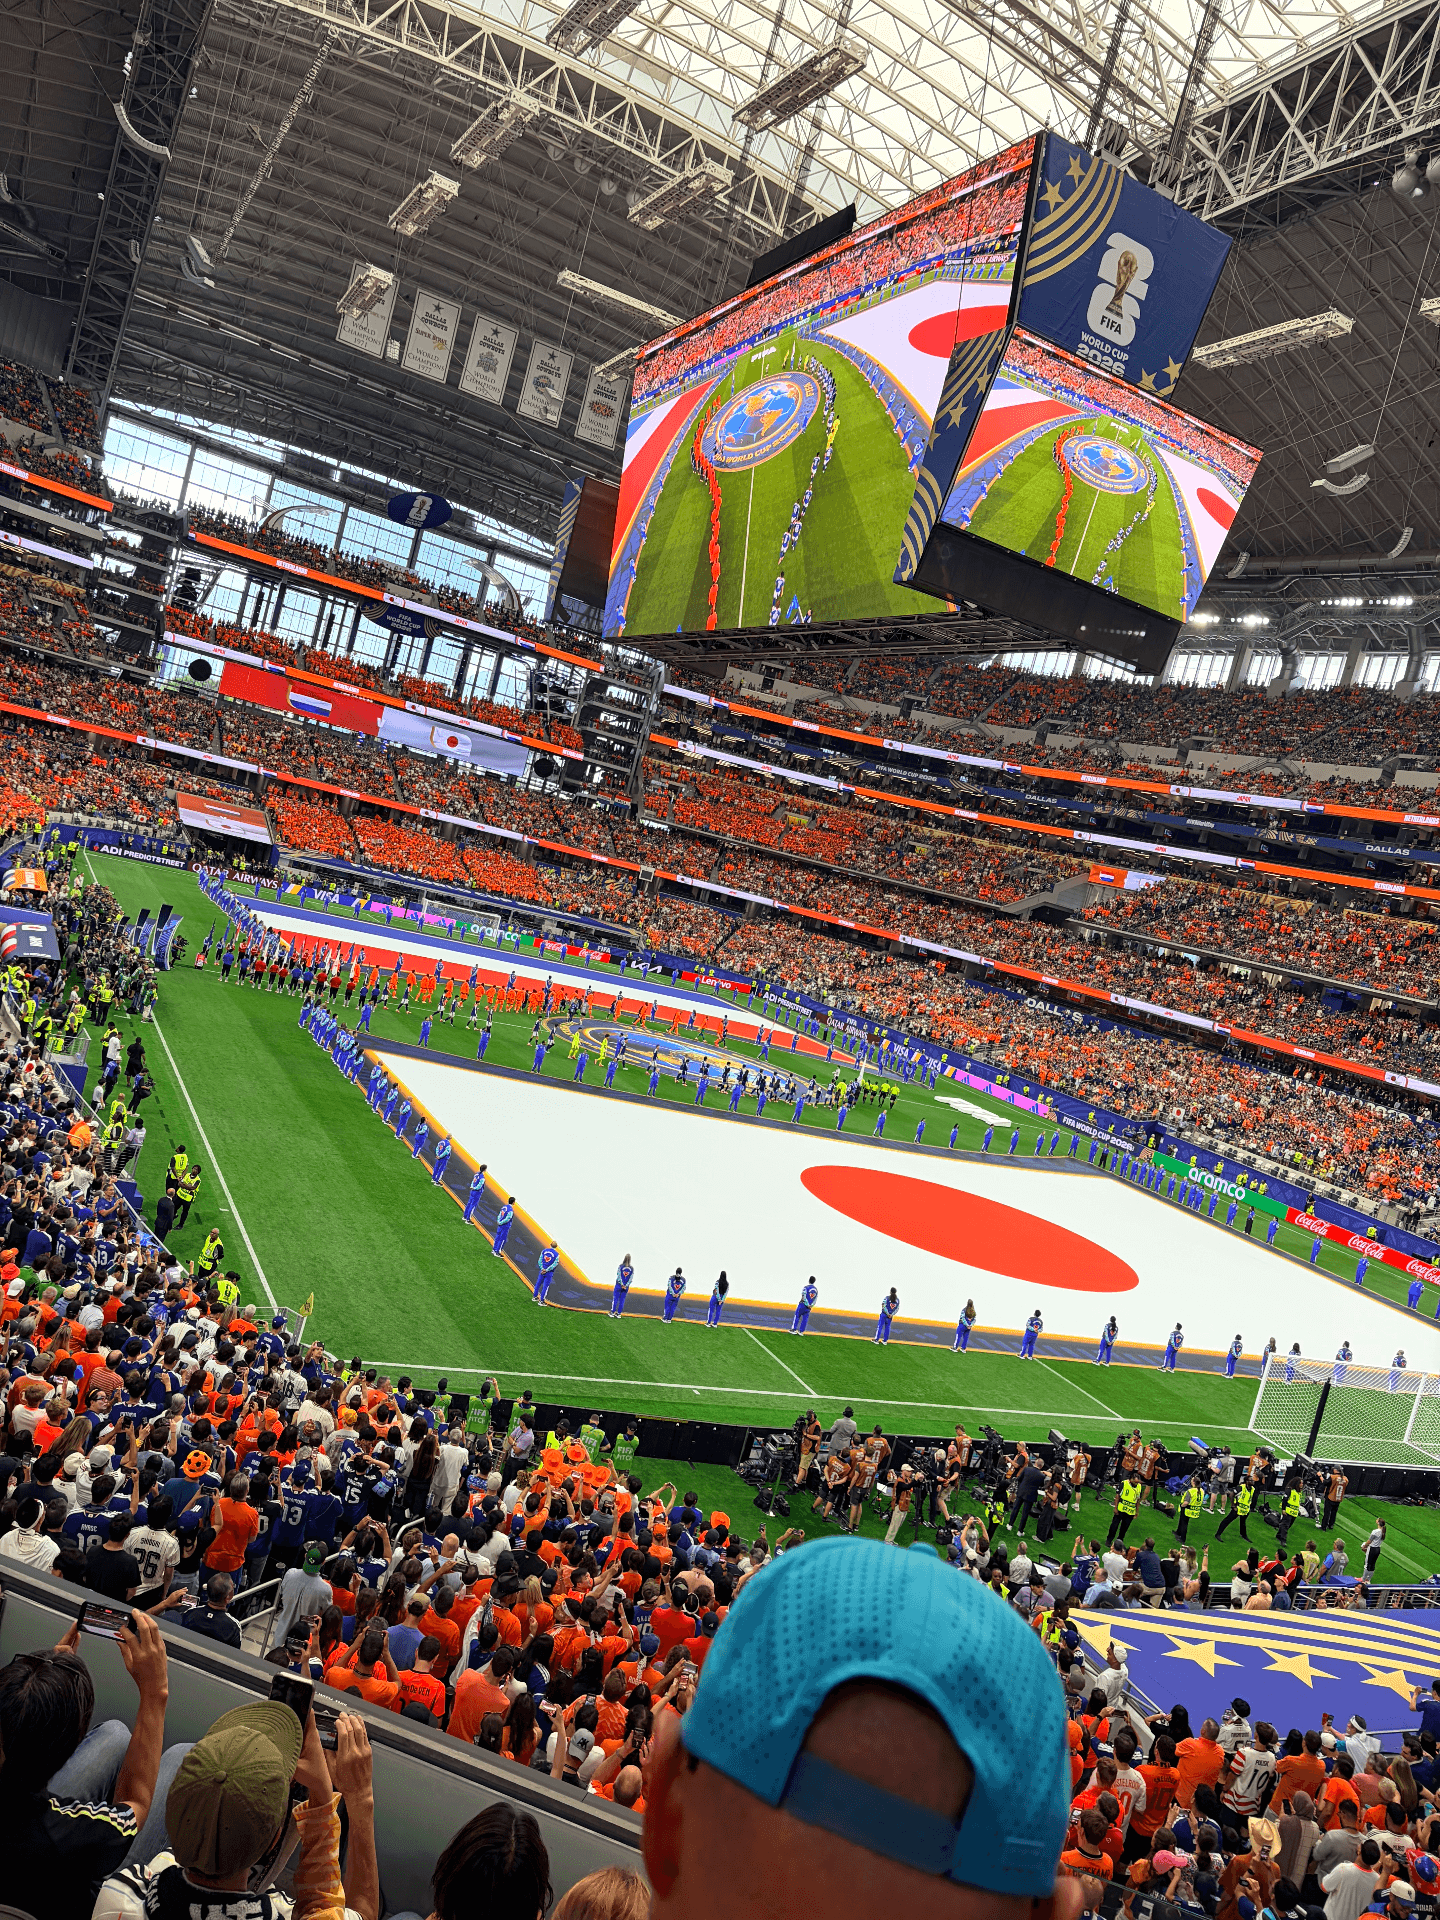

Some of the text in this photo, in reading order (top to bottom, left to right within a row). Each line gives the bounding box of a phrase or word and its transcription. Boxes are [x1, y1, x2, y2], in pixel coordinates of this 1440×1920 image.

[421, 317, 448, 332] COWBOYS
[424, 312, 447, 324] DALLAS
[1100, 315, 1122, 335] FIFA
[343, 325, 381, 346] CHAMPIONS
[352, 321, 376, 336] WORLD
[415, 328, 431, 339] SUPER
[479, 340, 505, 355] COWBOYS
[483, 335, 504, 348] DALLAS
[1081, 331, 1129, 362] WORLD CUP
[407, 352, 444, 371] CHAMPIONS
[416, 348, 439, 362] WORLD
[1076, 343, 1126, 378] 2026
[536, 364, 561, 379] COWBOYS
[540, 360, 560, 372] DALLAS
[465, 375, 501, 394] CHAMPIONS
[474, 371, 496, 384] WORLD
[593, 388, 618, 402] COWBOYS
[596, 384, 617, 396] DALLAS
[580, 422, 614, 439] CHAMPIONS
[588, 418, 609, 431] WORLD
[725, 451, 754, 463] WORLD
[754, 444, 772, 457] CUP
[386, 614, 408, 626] WORLD
[398, 613, 412, 622] FIFA
[751, 734, 786, 748] DALLAS
[875, 764, 938, 782] FIFA WORLD CUP 2026
[1025, 794, 1057, 805] DALLAS
[1404, 814, 1440, 826] NETHERLANDS
[100, 844, 123, 856] ADI
[1365, 844, 1411, 857] DALLAS
[192, 862, 278, 890] QATAR AIRWAYS
[313, 889, 340, 904] VISA
[470, 923, 518, 943] aramco
[597, 945, 611, 954] FIFA
[762, 991, 777, 1004] ADI
[1025, 997, 1083, 1022] DALLS
[826, 1017, 845, 1031] QATAR
[847, 1017, 858, 1027] FIFA
[893, 1043, 909, 1058] VISA
[1062, 1116, 1134, 1151] FIFA WORLD CUP 2026
[1188, 1167, 1246, 1200] aramco
[1295, 1212, 1332, 1236] Coca-Cola
[1348, 1235, 1388, 1260] Coca-Cola
[471, 1408, 486, 1417] FIFA
[581, 1434, 597, 1447] FIFA
[344, 1485, 361, 1504] 15
[281, 1503, 303, 1525] 13
[1247, 1769, 1270, 1790] 10
